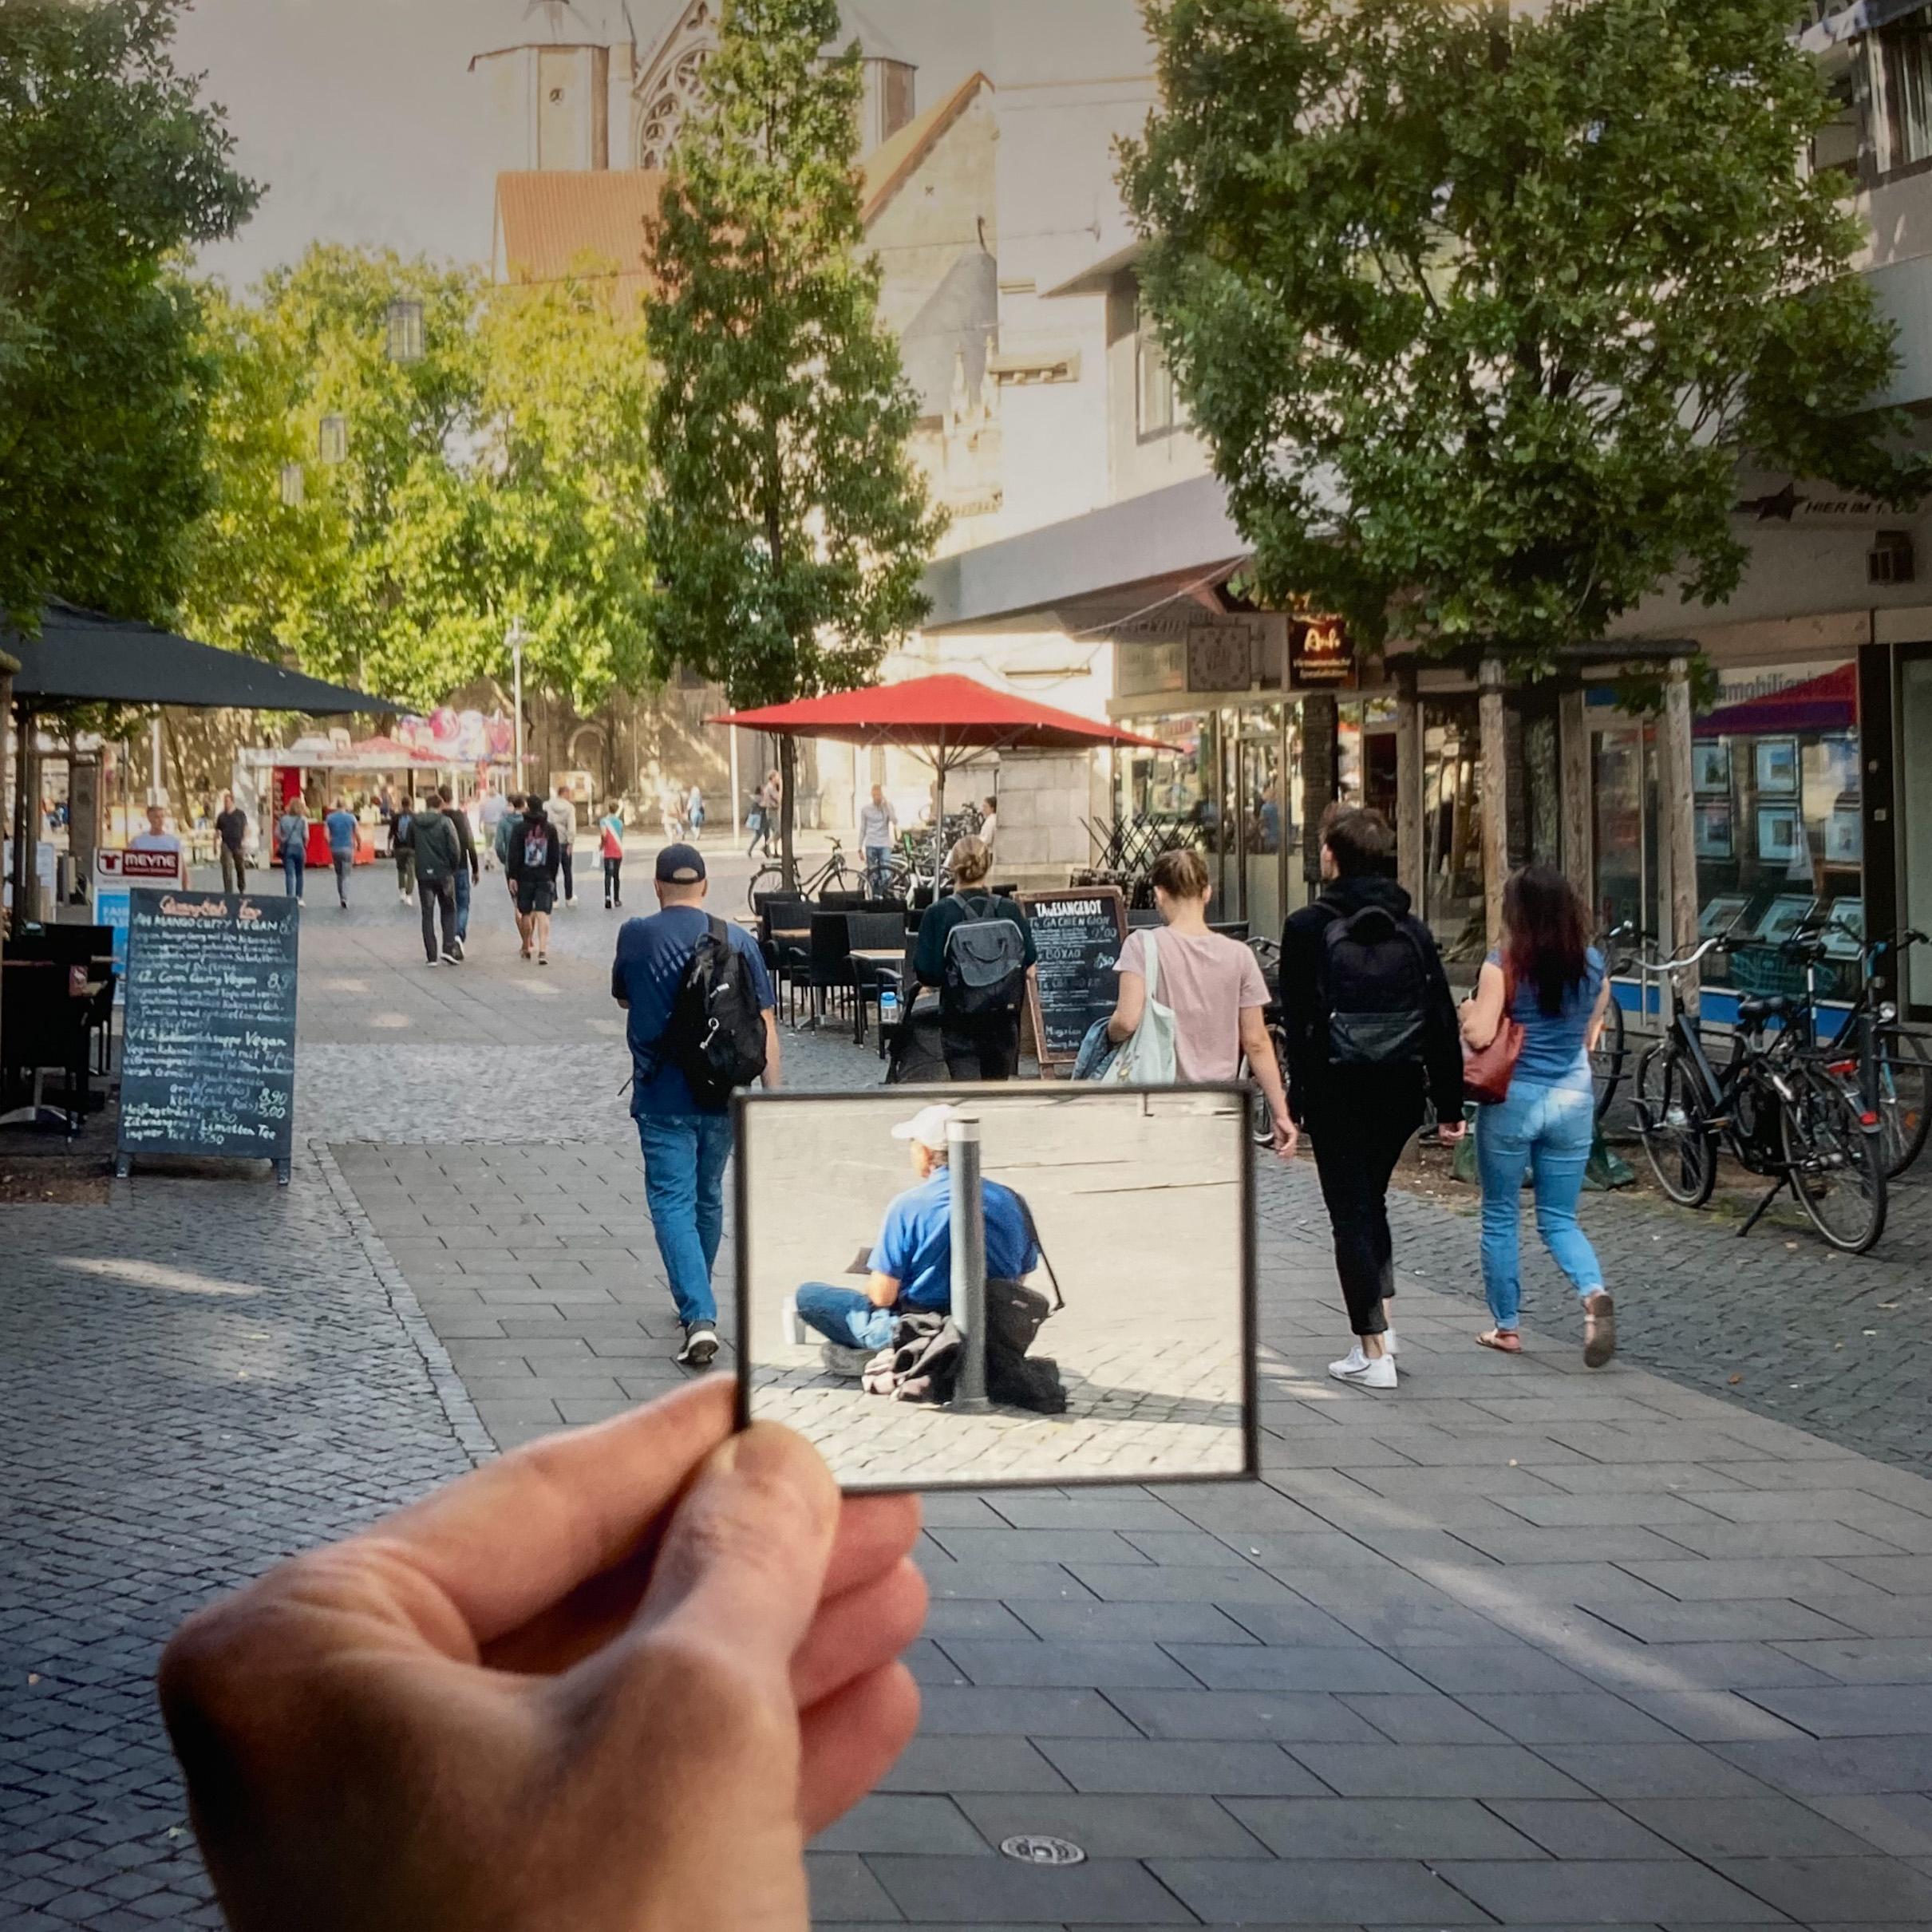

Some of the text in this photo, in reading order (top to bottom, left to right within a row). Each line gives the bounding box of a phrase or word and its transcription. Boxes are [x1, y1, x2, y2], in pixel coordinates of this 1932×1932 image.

[1805, 501, 1849, 515] HIER
[1851, 501, 1872, 515] IM
[245, 1030, 287, 1052] Vegan
